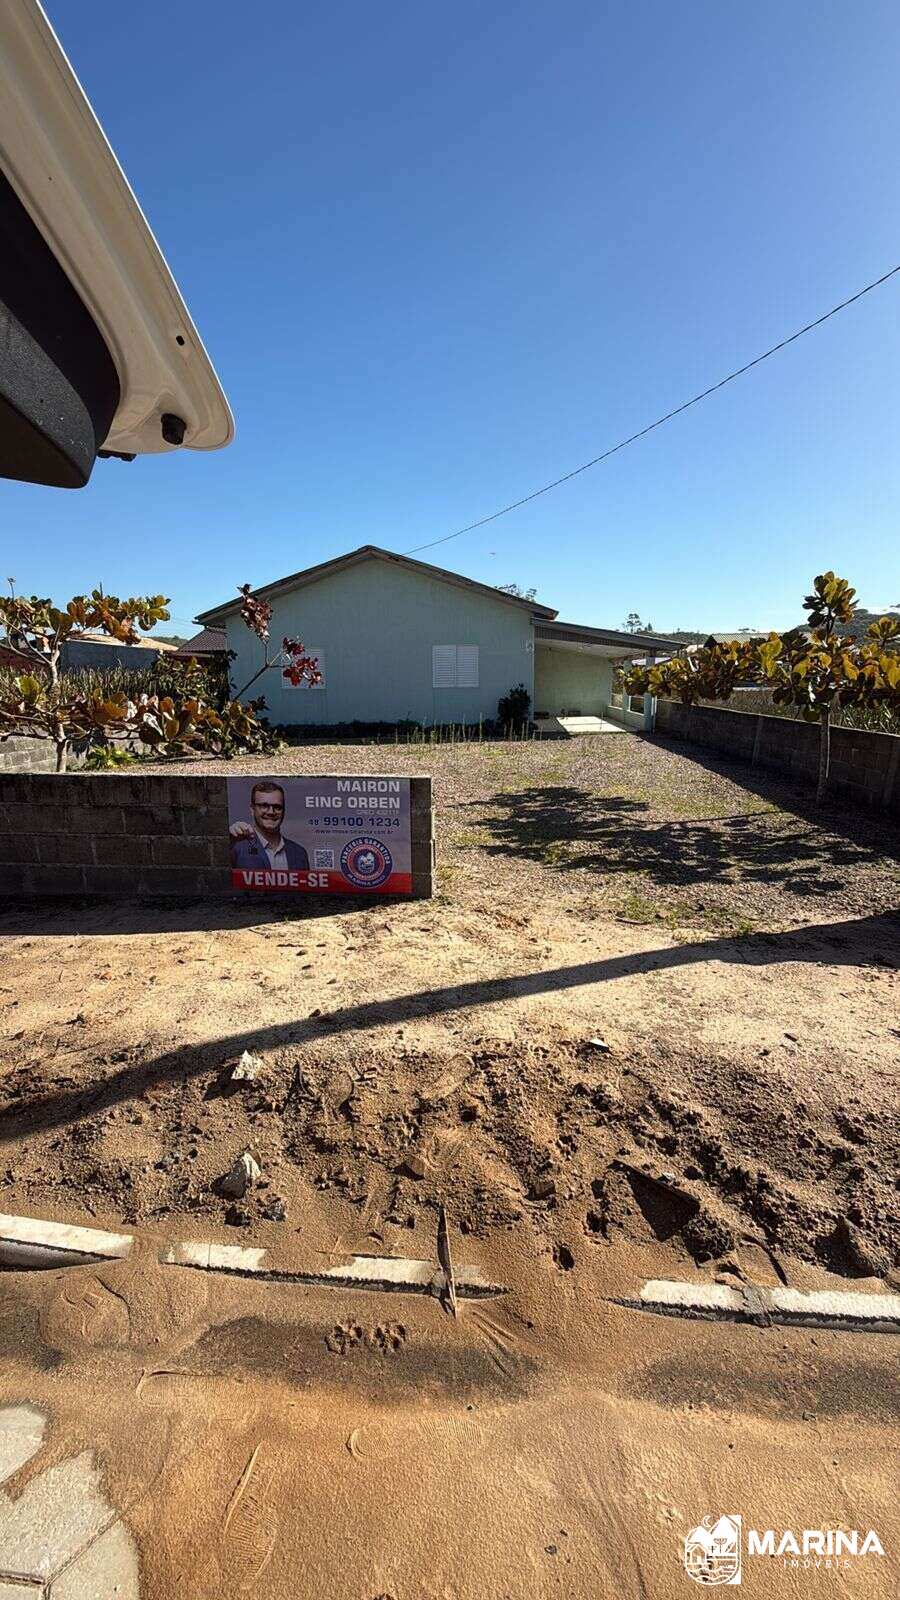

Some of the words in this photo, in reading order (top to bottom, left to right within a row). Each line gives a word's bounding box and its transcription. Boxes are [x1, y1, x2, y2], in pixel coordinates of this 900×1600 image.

[337, 780, 400, 793] MAIRON
[305, 796, 342, 808] EING
[347, 797, 400, 809] ORBEN
[323, 816, 363, 827] 99100
[368, 817, 400, 828] 1234
[242, 871, 329, 888] VENDE-SE
